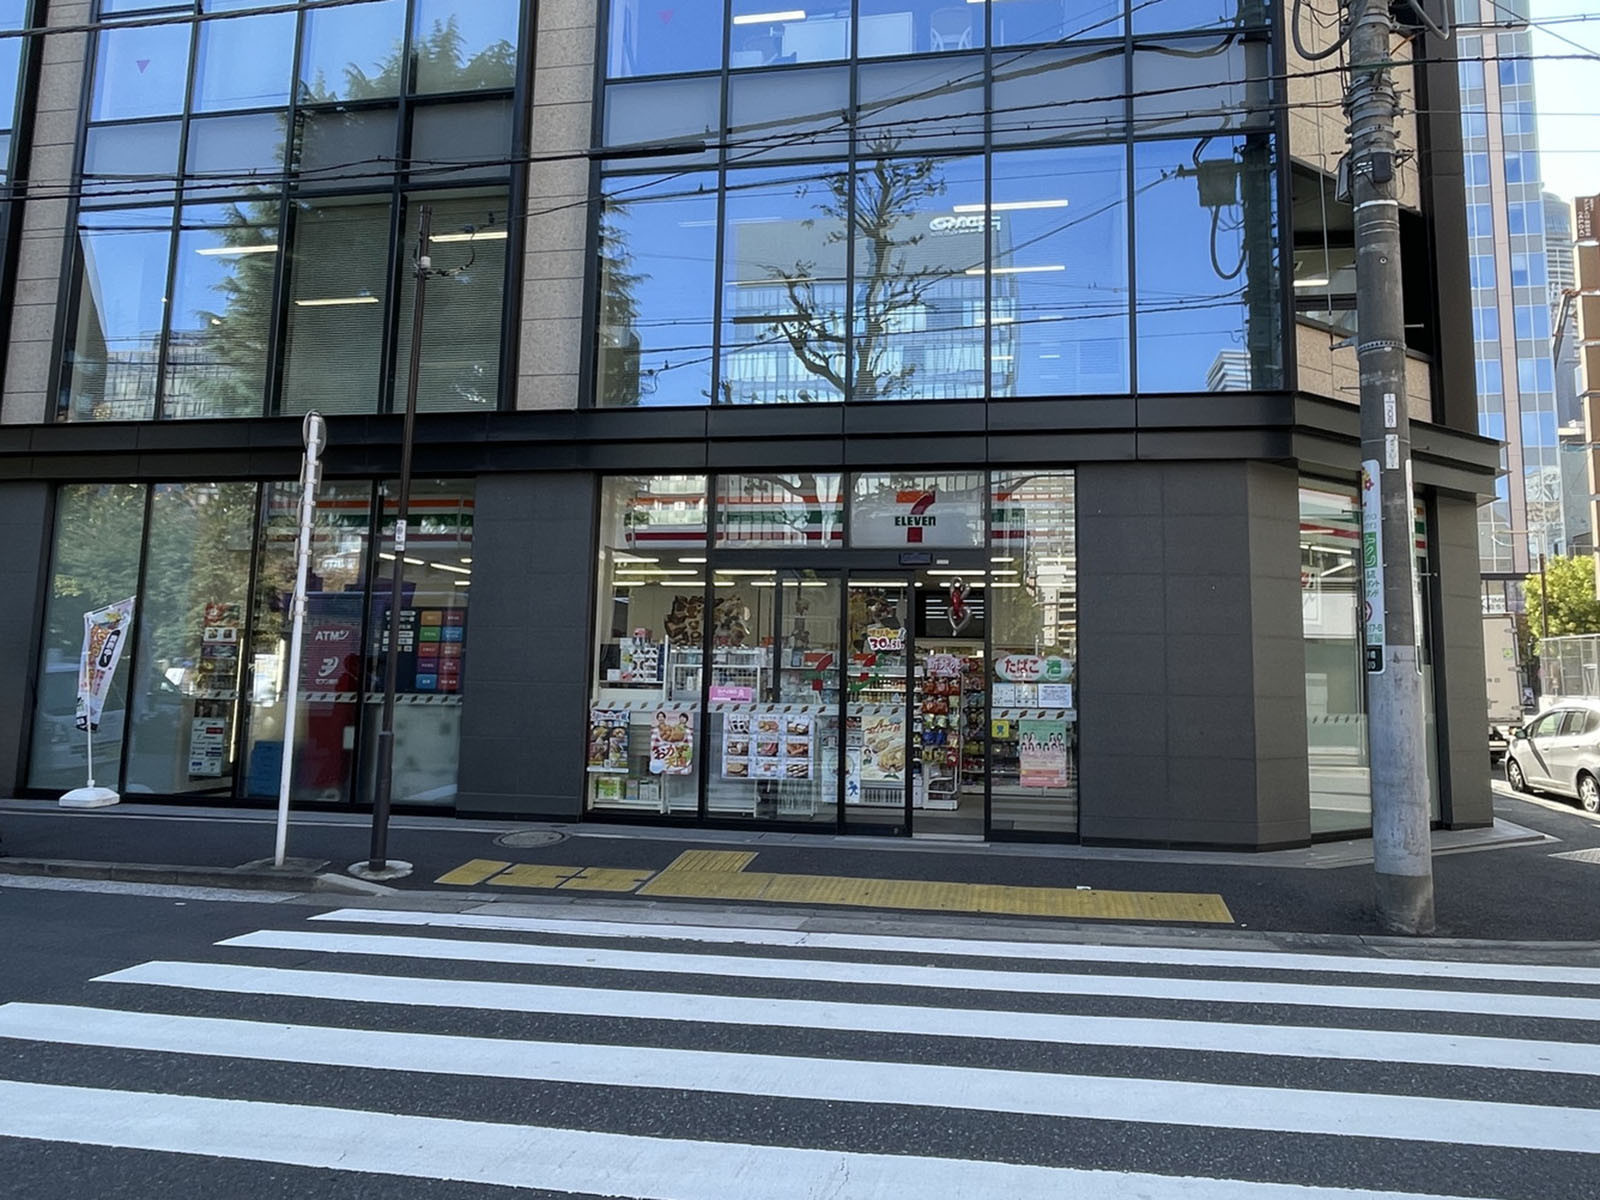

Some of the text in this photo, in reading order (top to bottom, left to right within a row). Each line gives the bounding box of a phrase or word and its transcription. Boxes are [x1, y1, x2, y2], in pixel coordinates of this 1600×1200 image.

[896, 491, 936, 543] 7
[315, 631, 338, 641] ATM
[1005, 659, 1039, 673] たばこ
[1046, 660, 1062, 674] 酒
